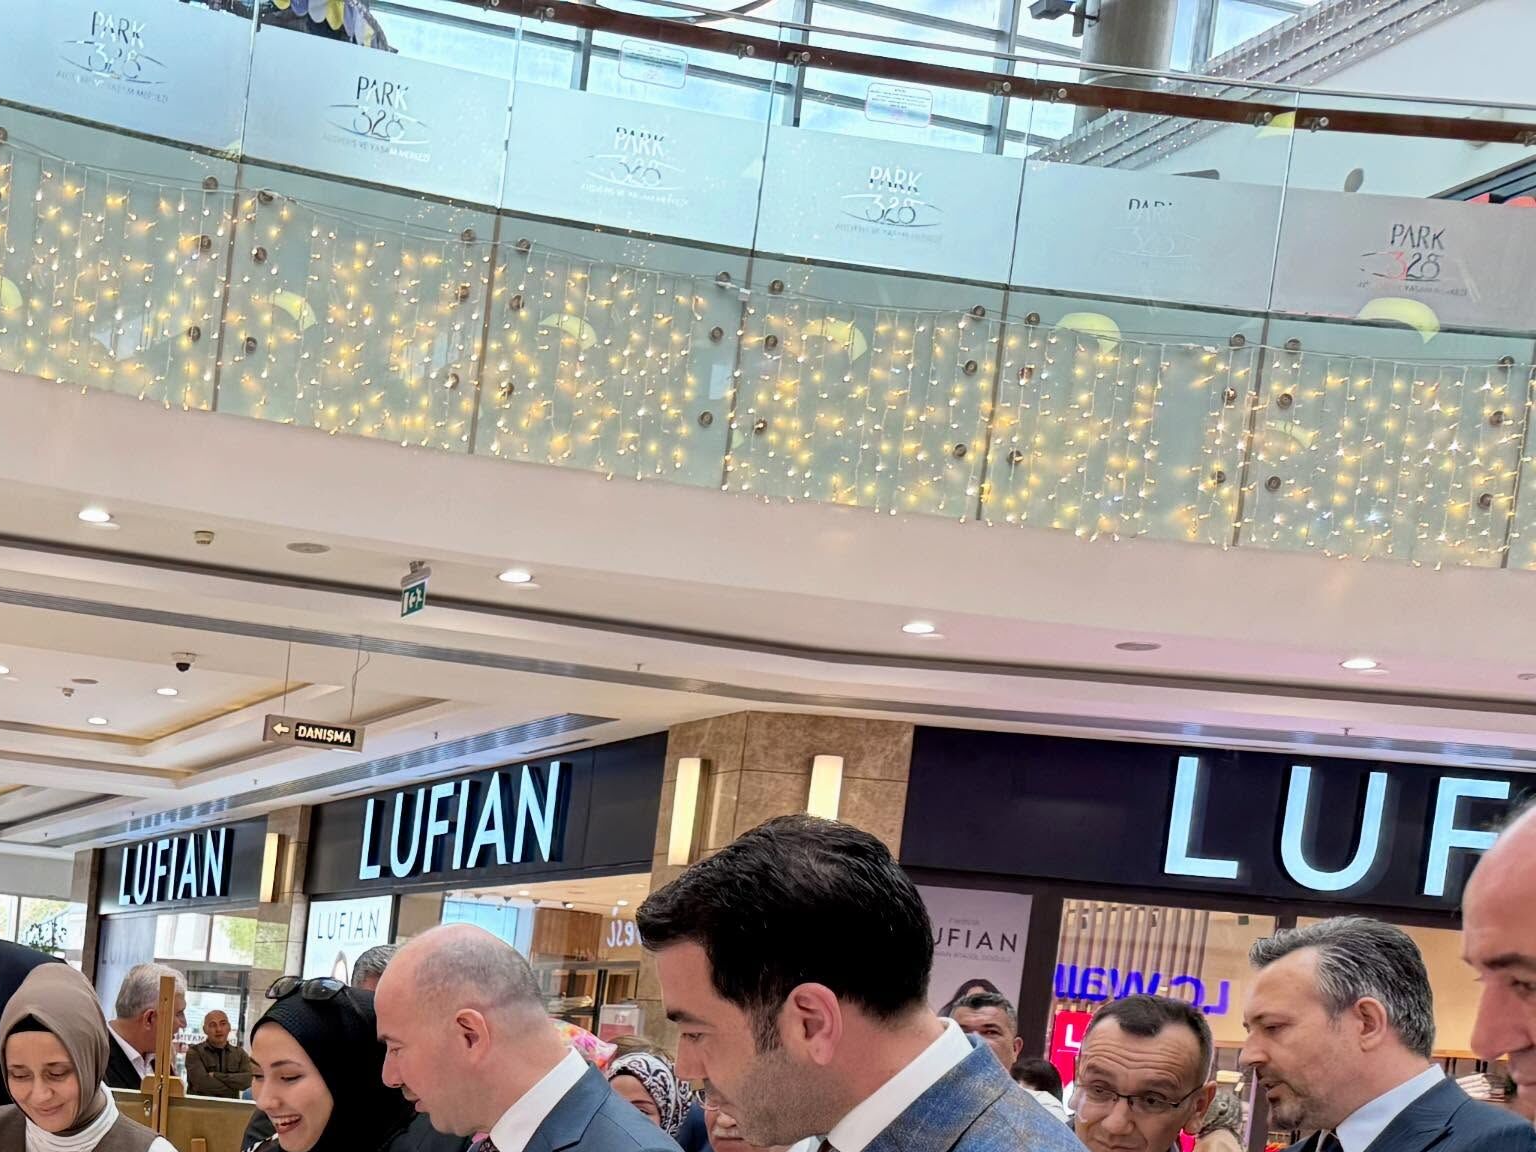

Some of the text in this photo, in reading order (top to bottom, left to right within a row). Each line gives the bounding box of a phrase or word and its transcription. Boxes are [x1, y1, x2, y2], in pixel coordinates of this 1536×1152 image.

[91, 11, 146, 49] PARK
[356, 75, 408, 111] PARK
[614, 126, 664, 157] PARK
[868, 166, 922, 195] PARK
[1390, 223, 1445, 250] PARK
[1386, 252, 1440, 280] 328
[297, 725, 352, 744] DANIŞMA
[359, 760, 561, 880] LUFIAN
[119, 827, 227, 906] LUFIAN
[317, 906, 380, 940] LUFIAN
